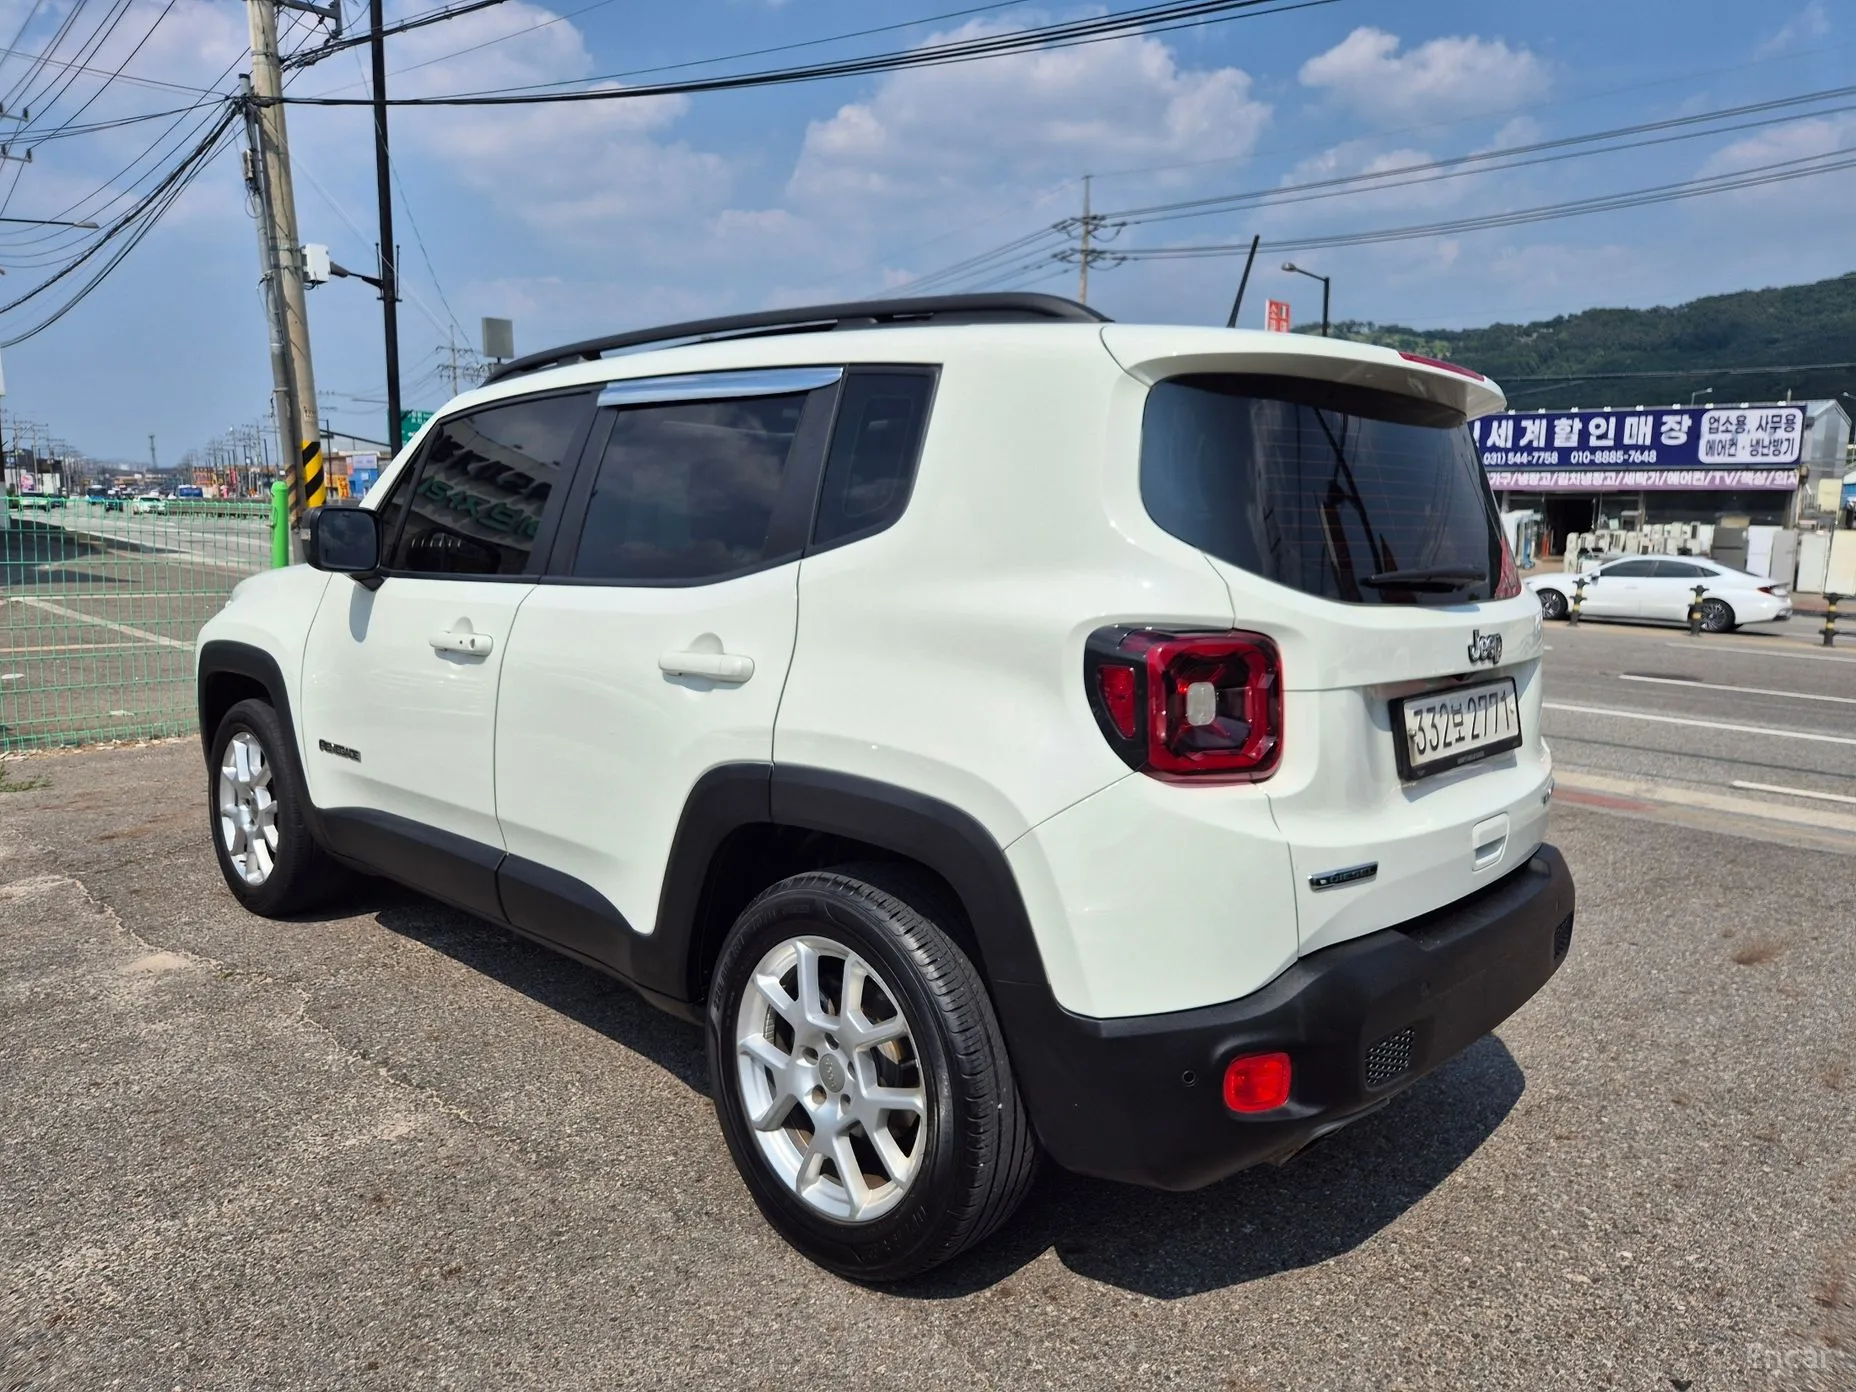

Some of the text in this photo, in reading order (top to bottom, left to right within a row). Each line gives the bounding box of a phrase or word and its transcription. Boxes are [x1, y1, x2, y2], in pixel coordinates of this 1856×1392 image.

[1755, 413, 1796, 433] 사무용
[1705, 437, 1795, 457] 에어컨 냉난방기
[1468, 629, 1502, 664] Jeep
